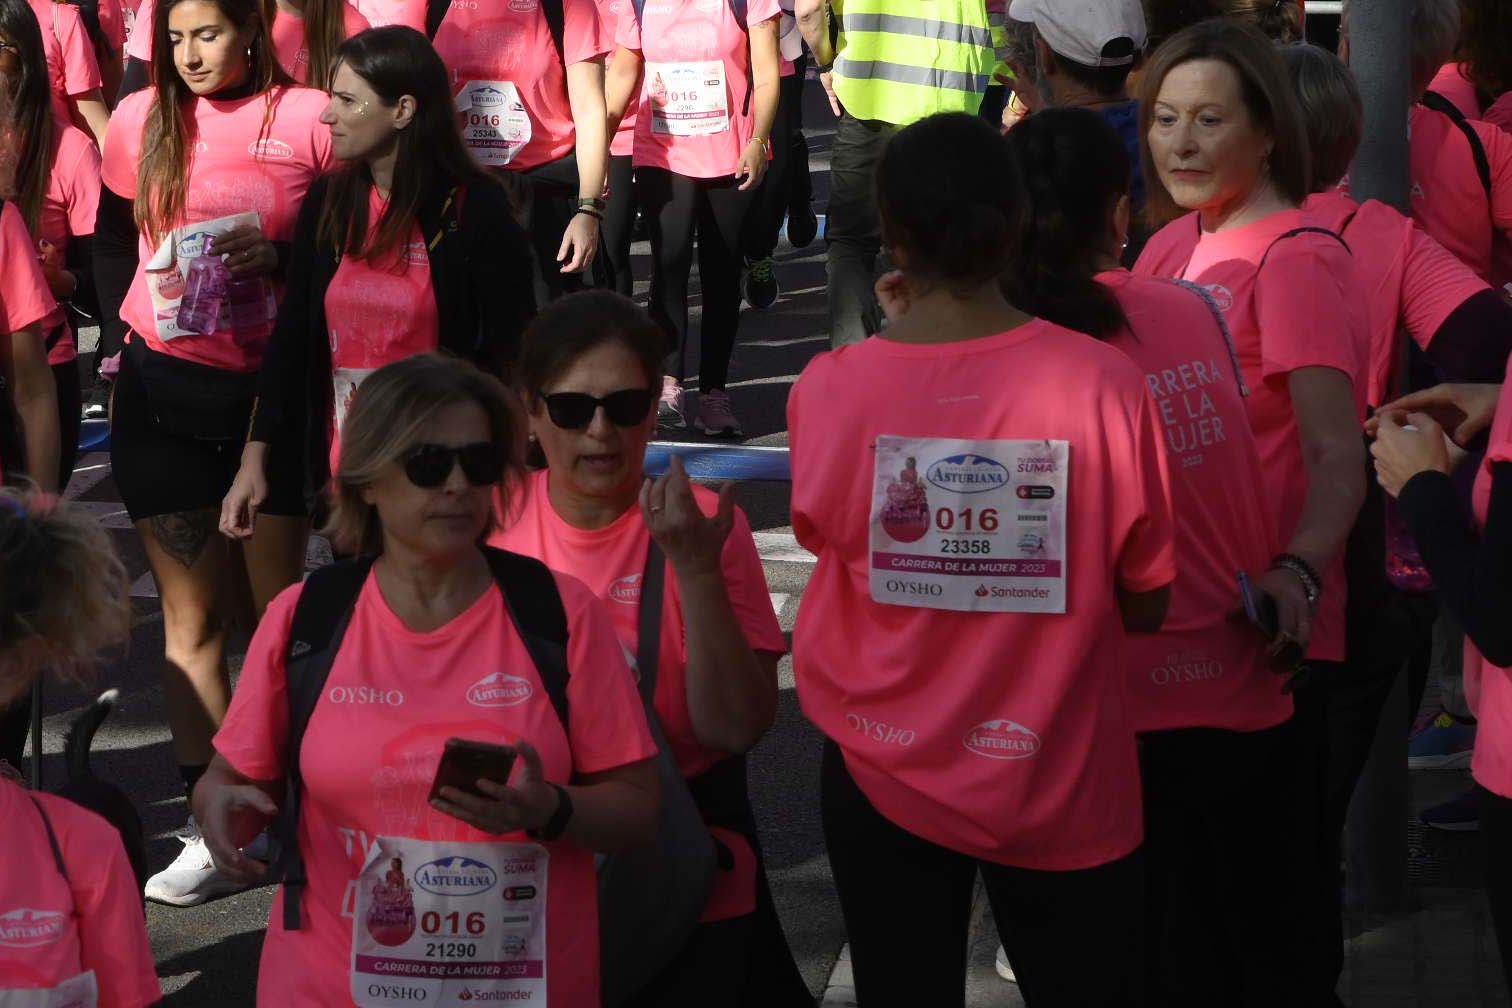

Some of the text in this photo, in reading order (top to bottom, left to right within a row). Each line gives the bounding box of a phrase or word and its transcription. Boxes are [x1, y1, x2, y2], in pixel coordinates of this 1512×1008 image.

[671, 91, 697, 102] 016
[471, 114, 500, 126] 016
[1146, 359, 1224, 399] RRERA
[1159, 388, 1216, 425] E LA
[1167, 416, 1226, 453] UJER
[932, 467, 1003, 484] ASTURIANA
[1017, 464, 1054, 473] SUMA
[935, 507, 999, 531] 016
[941, 539, 991, 554] 23358
[891, 558, 1046, 573] CARRERA DE LA MUJER 2023
[886, 580, 943, 597] OYSHO
[991, 586, 1050, 599] Santander
[1151, 661, 1222, 686] OYSHO
[330, 686, 404, 707] OYSHO
[473, 682, 531, 702] ASTURIANA
[845, 713, 915, 747] OYSHO
[967, 732, 1035, 753] ASTURIANA
[416, 870, 492, 887] ASTURIANA
[504, 865, 536, 875] SUMA
[421, 911, 486, 935] 016
[426, 942, 477, 959] 21290
[374, 962, 428, 974] CARRERA
[430, 965, 445, 975] DE
[446, 966, 462, 975] LA
[463, 966, 502, 976] MUJER
[368, 983, 427, 1002] OYSHO
[474, 989, 533, 1002] Santander
